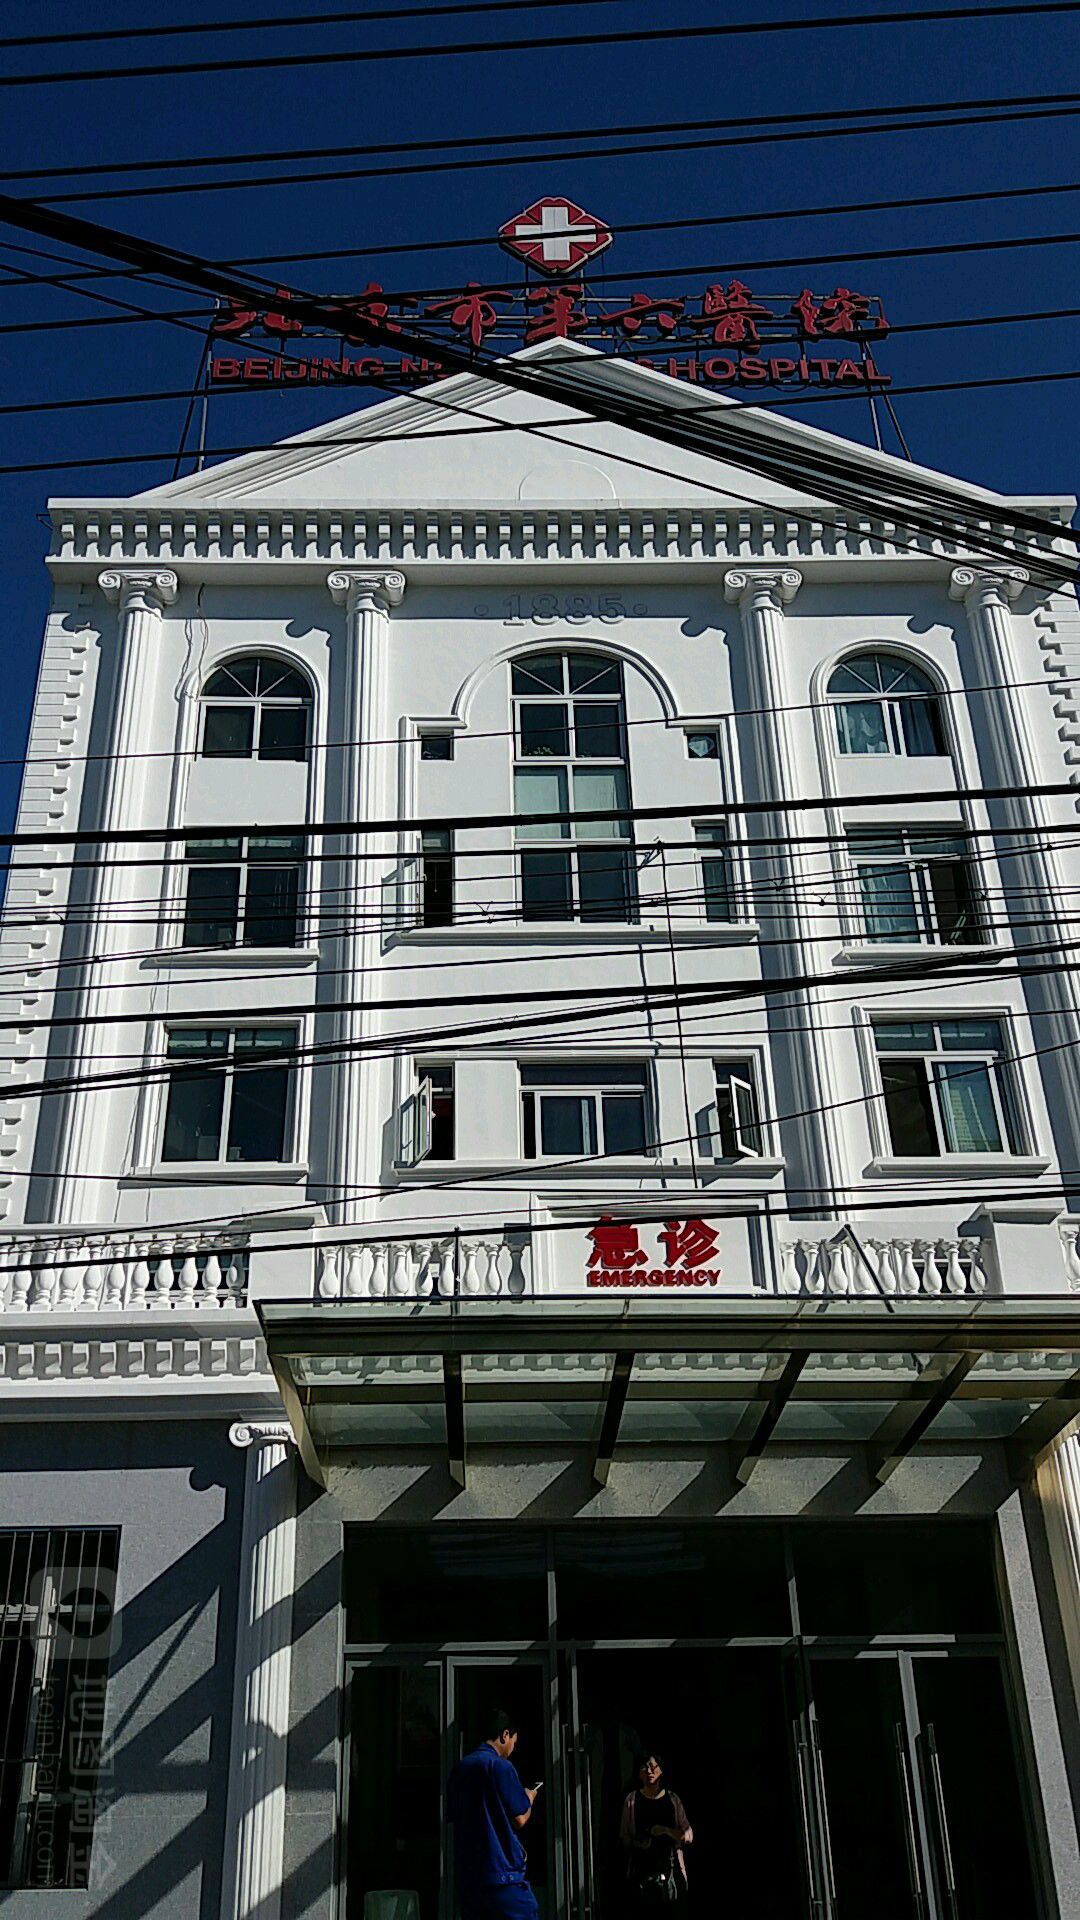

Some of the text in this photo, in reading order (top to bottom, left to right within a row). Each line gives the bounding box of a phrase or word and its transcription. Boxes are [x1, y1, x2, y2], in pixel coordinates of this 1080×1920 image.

[211, 357, 385, 380] BEIJING
[668, 357, 892, 382] HOSPITAL
[502, 592, 627, 627] 1885
[585, 1215, 721, 1270] 急诊
[586, 1268, 722, 1288] EMERGENCY
